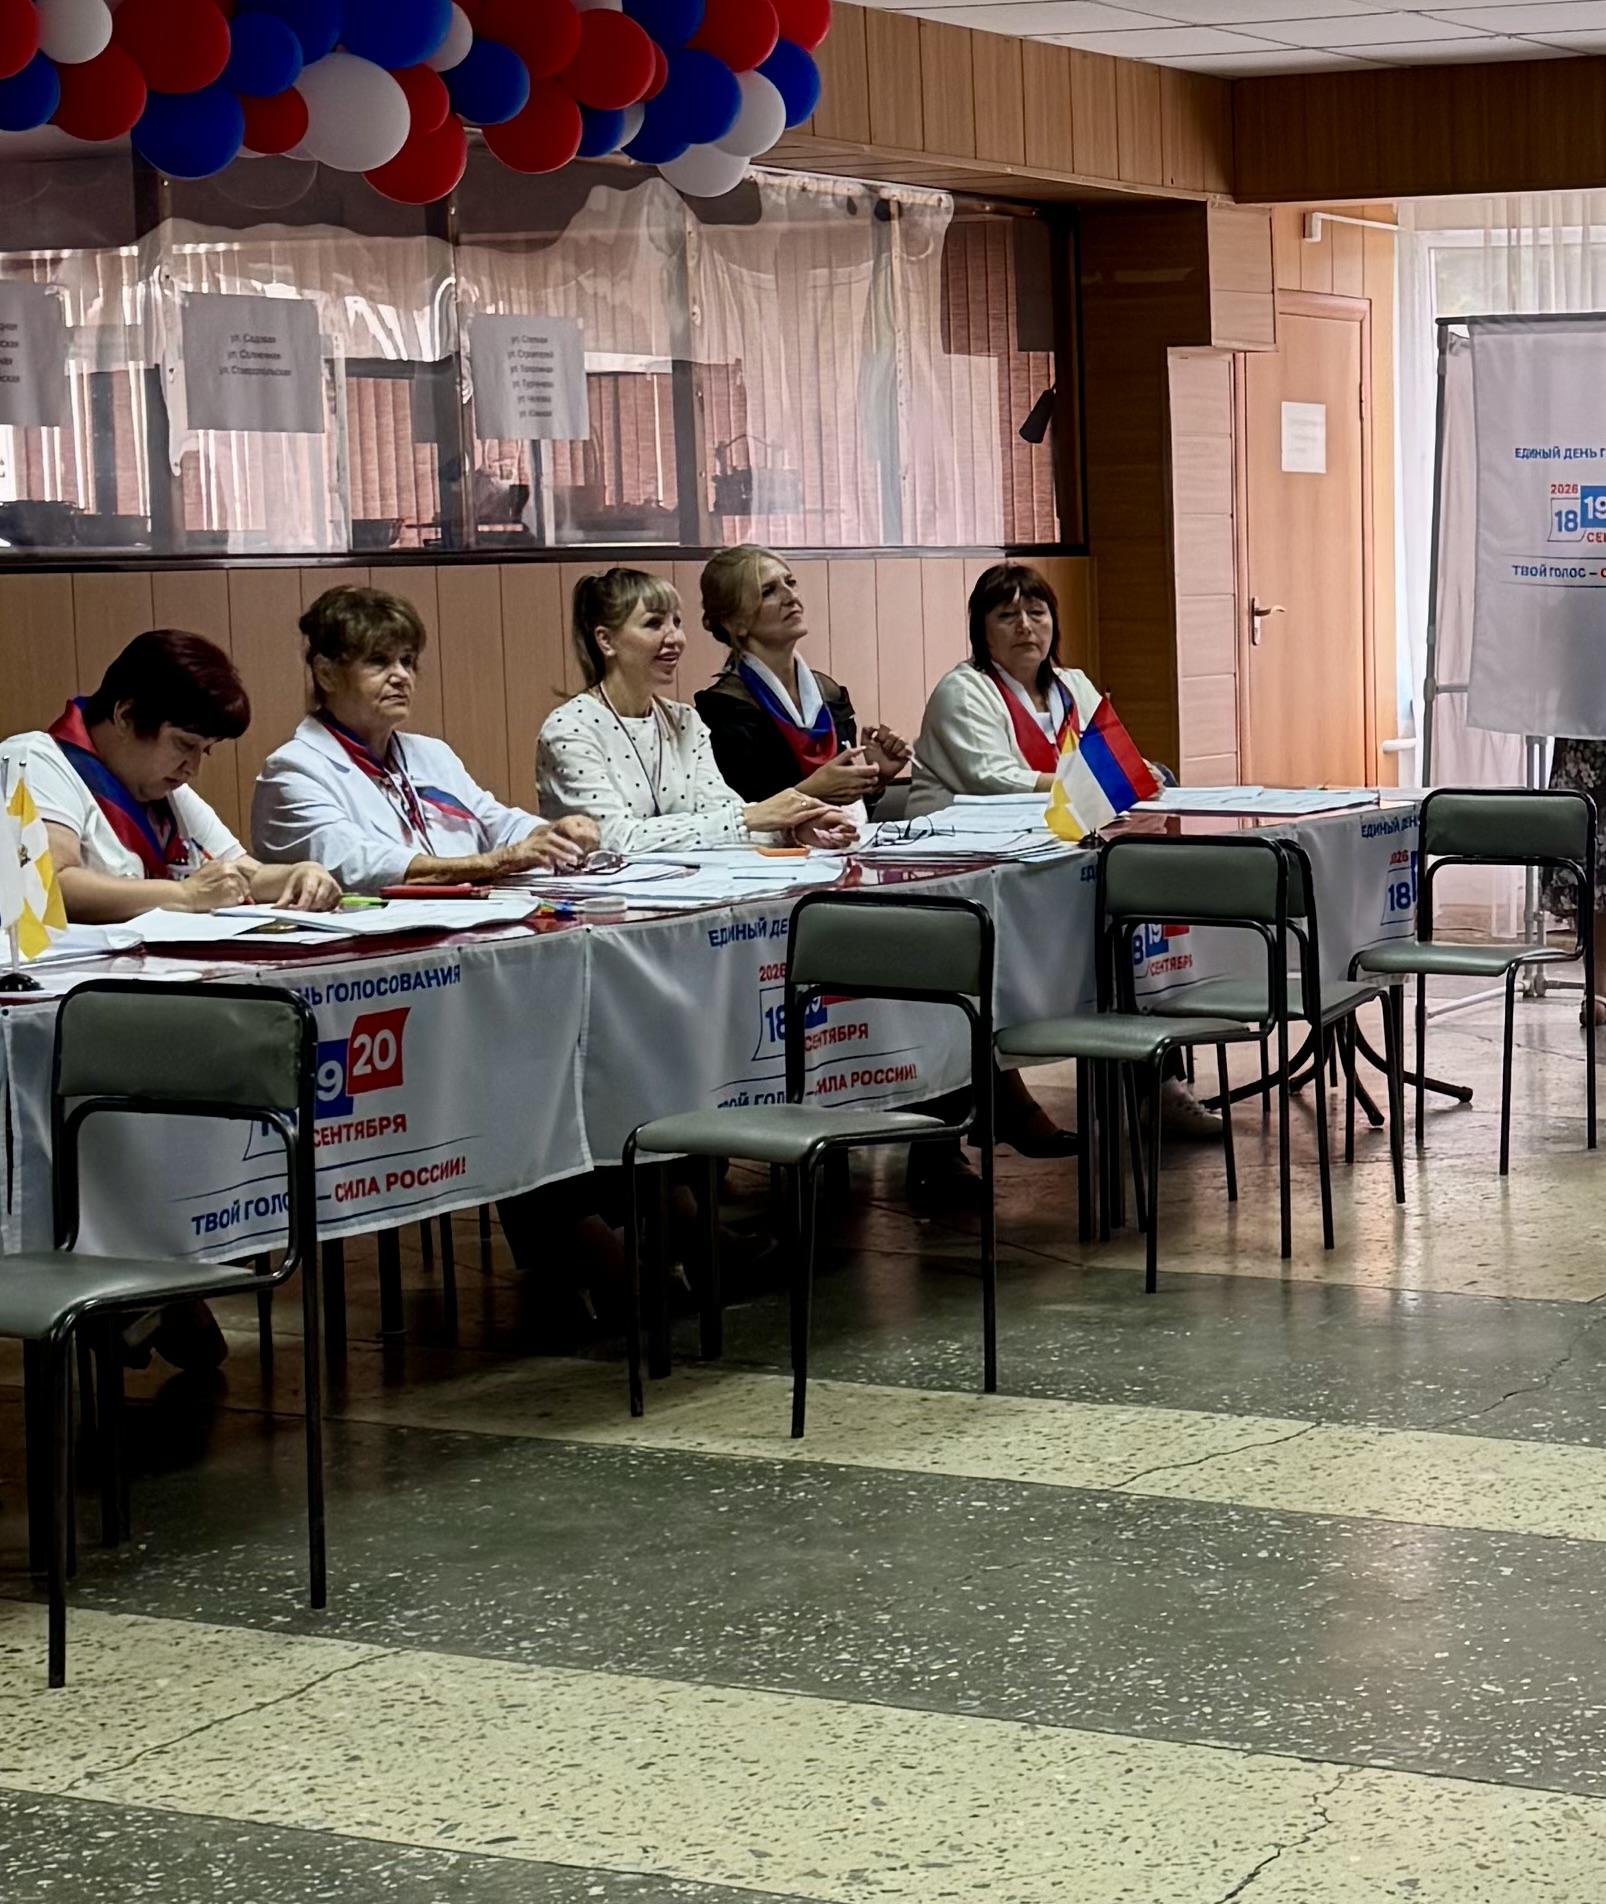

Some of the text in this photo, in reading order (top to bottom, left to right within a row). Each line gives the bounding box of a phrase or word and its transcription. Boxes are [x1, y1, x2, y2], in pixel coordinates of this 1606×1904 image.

[1515, 446, 1561, 460] ЕДИНЫЙ
[1563, 448, 1597, 460] ДЕНЬ
[1550, 484, 1579, 494] 2026
[1554, 510, 1579, 533] 18
[1512, 564, 1547, 577] ТВОЙ
[1549, 567, 1586, 578] ГОЛОС
[1361, 817, 1400, 838] ЕДИНЫЙ
[1388, 882, 1411, 911] 18
[708, 917, 788, 947] ЕДИНЫЙ ДЕ
[326, 964, 461, 1004] ГОЛОСОВАНИЯ
[759, 963, 787, 982] 2026
[765, 1004, 786, 1042] 18
[316, 1028, 397, 1102] 9 20
[815, 1075, 848, 1095] ИЛА
[850, 1063, 917, 1088] РОССИИ!
[314, 1114, 407, 1148] СЕНТЯБРЯ
[191, 1200, 240, 1235] ТВОЙ
[334, 1176, 380, 1202] СИЛА
[386, 1156, 466, 1192] РОССИИ!
